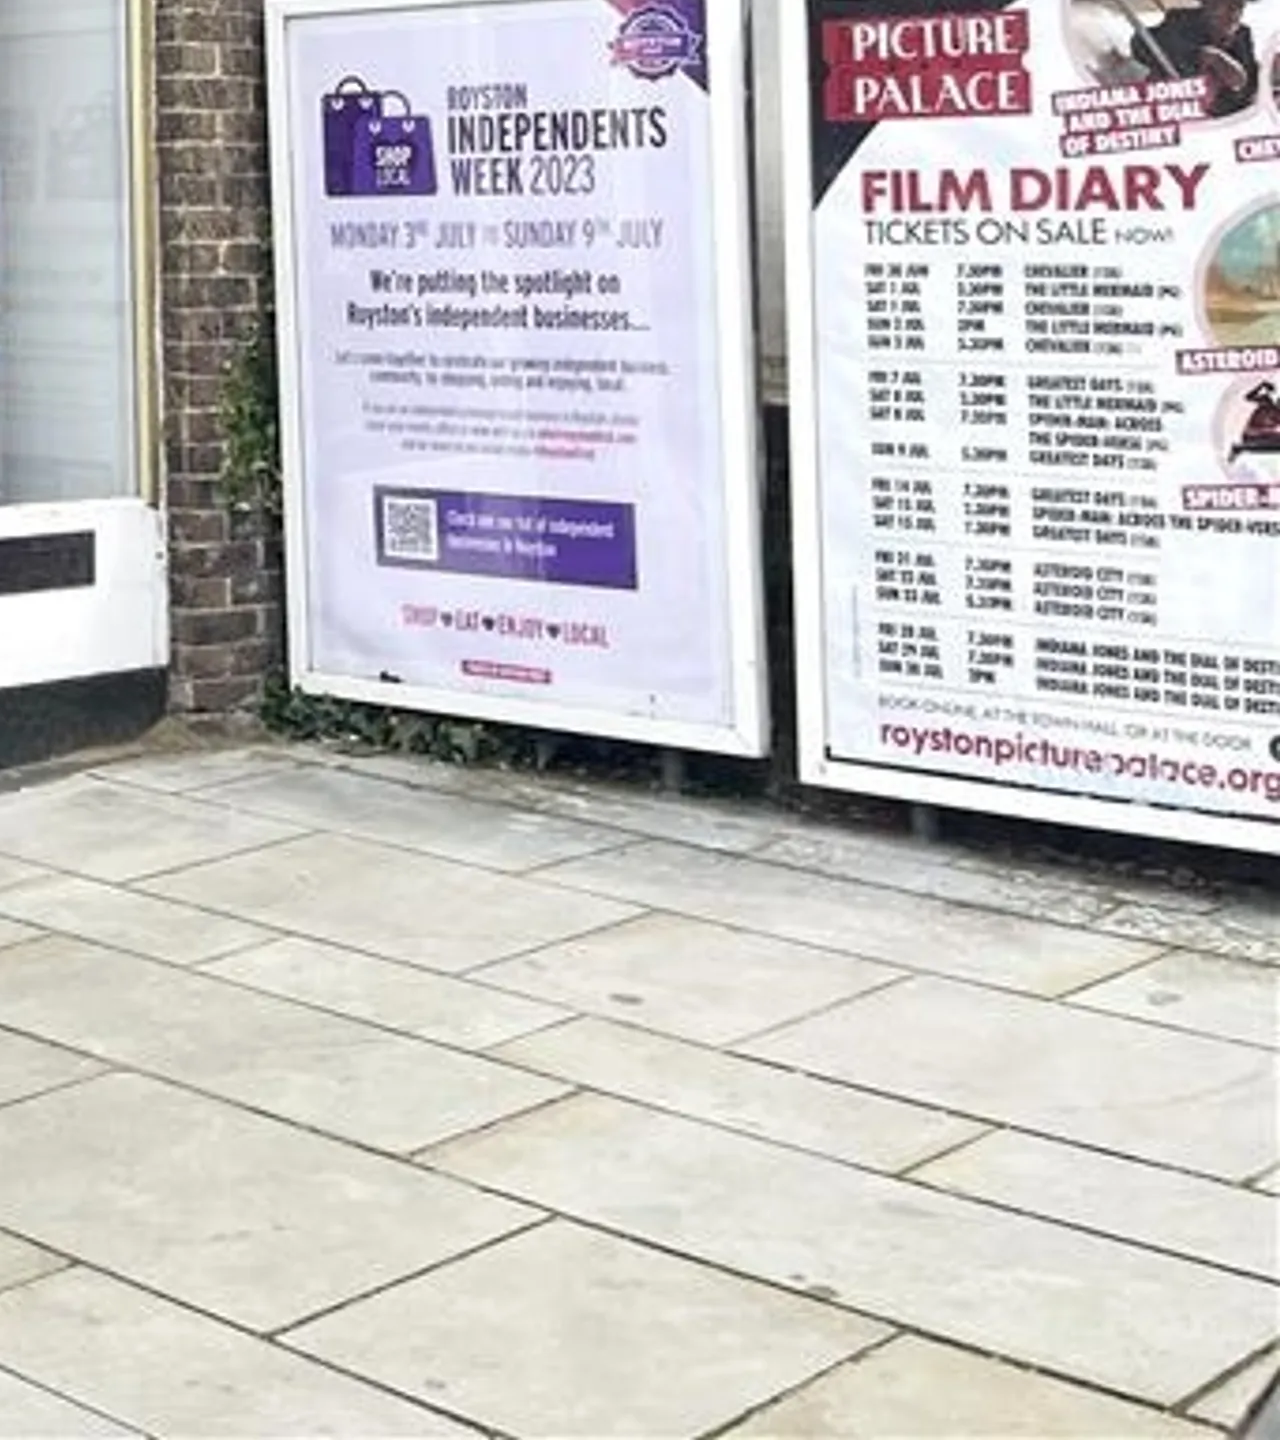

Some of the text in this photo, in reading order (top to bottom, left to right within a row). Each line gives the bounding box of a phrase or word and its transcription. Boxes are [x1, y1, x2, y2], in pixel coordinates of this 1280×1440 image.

[852, 15, 1021, 61] PICTURE
[448, 83, 527, 110] ROYSTON
[853, 71, 1021, 114] PALACE
[1057, 77, 1207, 113] INDIANA JONES
[448, 106, 667, 154] INDEPENDENTS
[1070, 111, 1113, 132] AND
[1116, 106, 1153, 128] THE
[376, 146, 412, 167] SHOP
[1065, 126, 1177, 157] OF DESTINY
[376, 166, 412, 186] LOCAL
[451, 154, 596, 197] WEEK 2023
[861, 162, 1211, 213] FILM DIARY
[331, 221, 399, 248] MONDAY
[436, 221, 476, 248] JULY
[502, 220, 577, 248] SUNDAY
[617, 218, 663, 248] JULY
[864, 220, 970, 246] TICKETS
[976, 218, 1030, 246] ON
[1036, 216, 1107, 245] SALE
[370, 270, 621, 300] We're putting the spotlight on
[347, 301, 422, 330] Royston's
[426, 302, 528, 331] independent
[1180, 347, 1279, 371] ASTEROID
